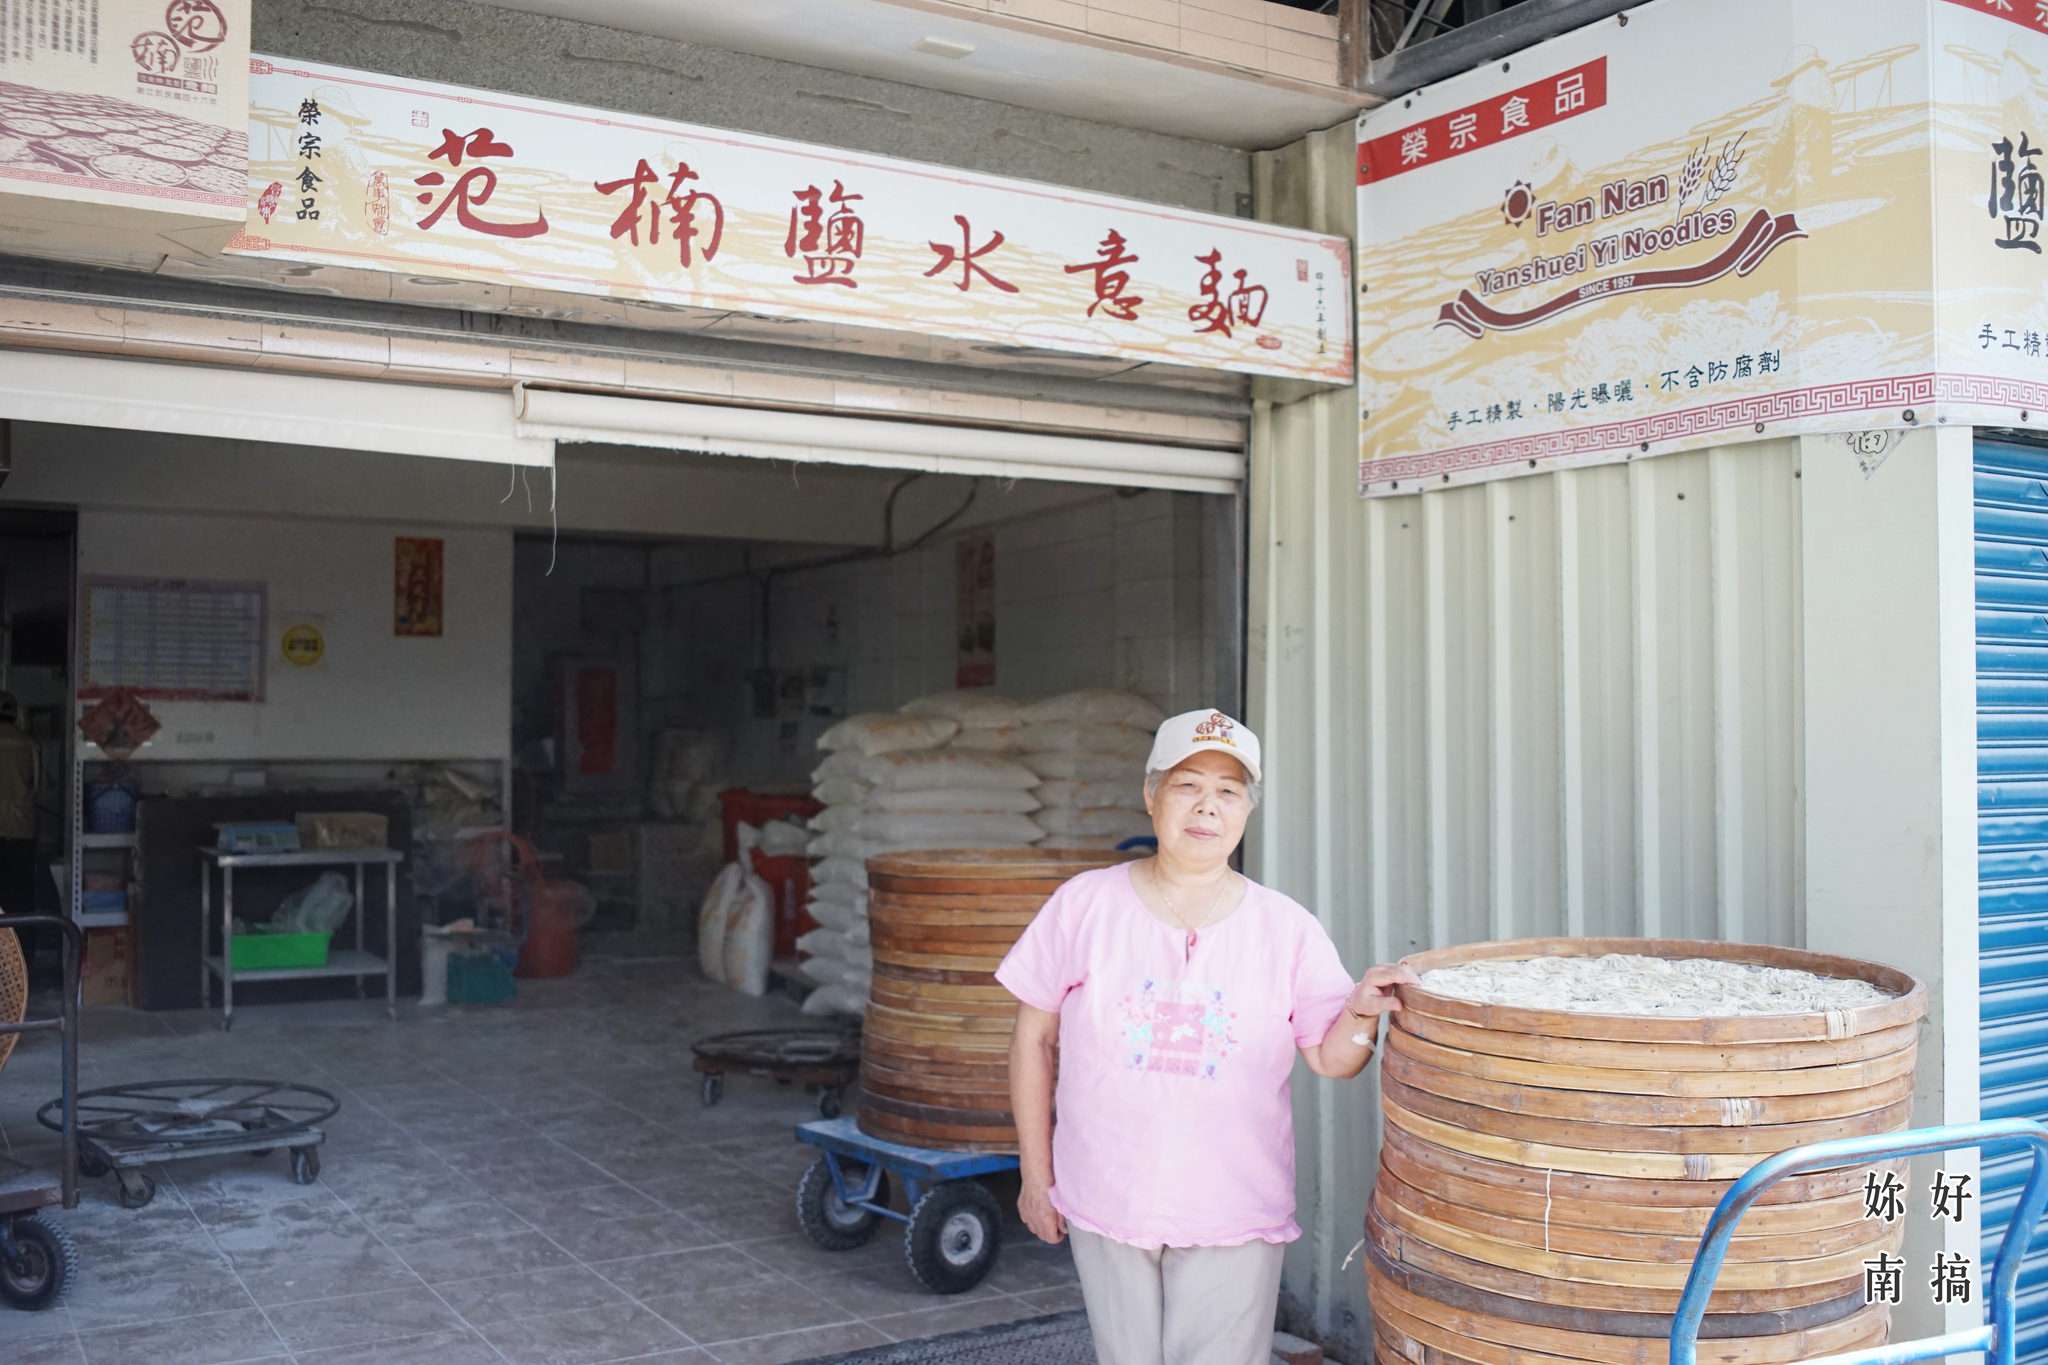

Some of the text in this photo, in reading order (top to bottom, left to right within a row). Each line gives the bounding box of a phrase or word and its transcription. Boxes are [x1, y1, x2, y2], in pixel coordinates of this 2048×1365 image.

[296, 99, 323, 222] 榮宗食品
[1401, 73, 1585, 165] 榮宗食品
[414, 127, 1268, 338] 范楠鹽水意麵
[1536, 173, 1670, 238] Fan Nan
[1988, 130, 2045, 255] 鹽
[1475, 207, 1736, 297] Yanshuei Yi Noodles
[1577, 275, 1637, 300] SINCE 1957
[1978, 323, 2048, 358] 手工精
